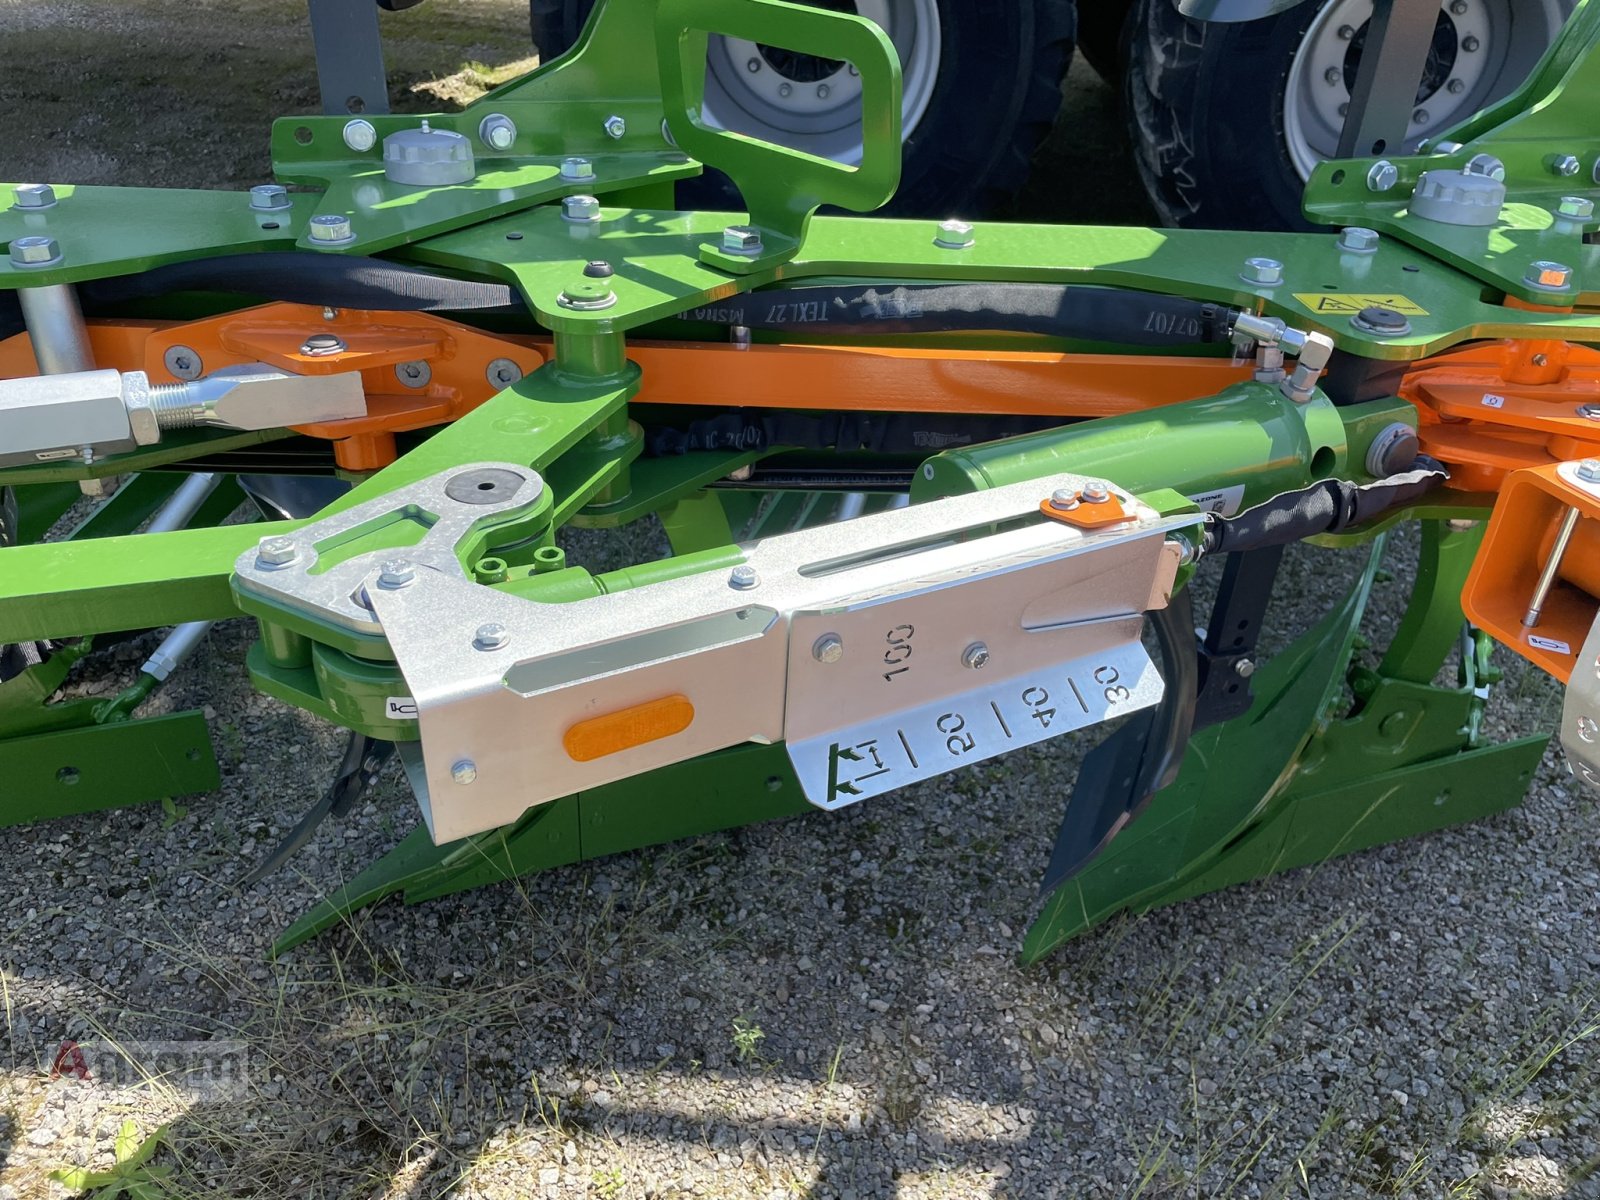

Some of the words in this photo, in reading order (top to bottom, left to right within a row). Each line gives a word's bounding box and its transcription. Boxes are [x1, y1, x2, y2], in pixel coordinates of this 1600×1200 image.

[882, 624, 915, 683] 100
[1094, 665, 1131, 705] 30
[1021, 686, 1057, 729] 40
[936, 712, 976, 756] 50
